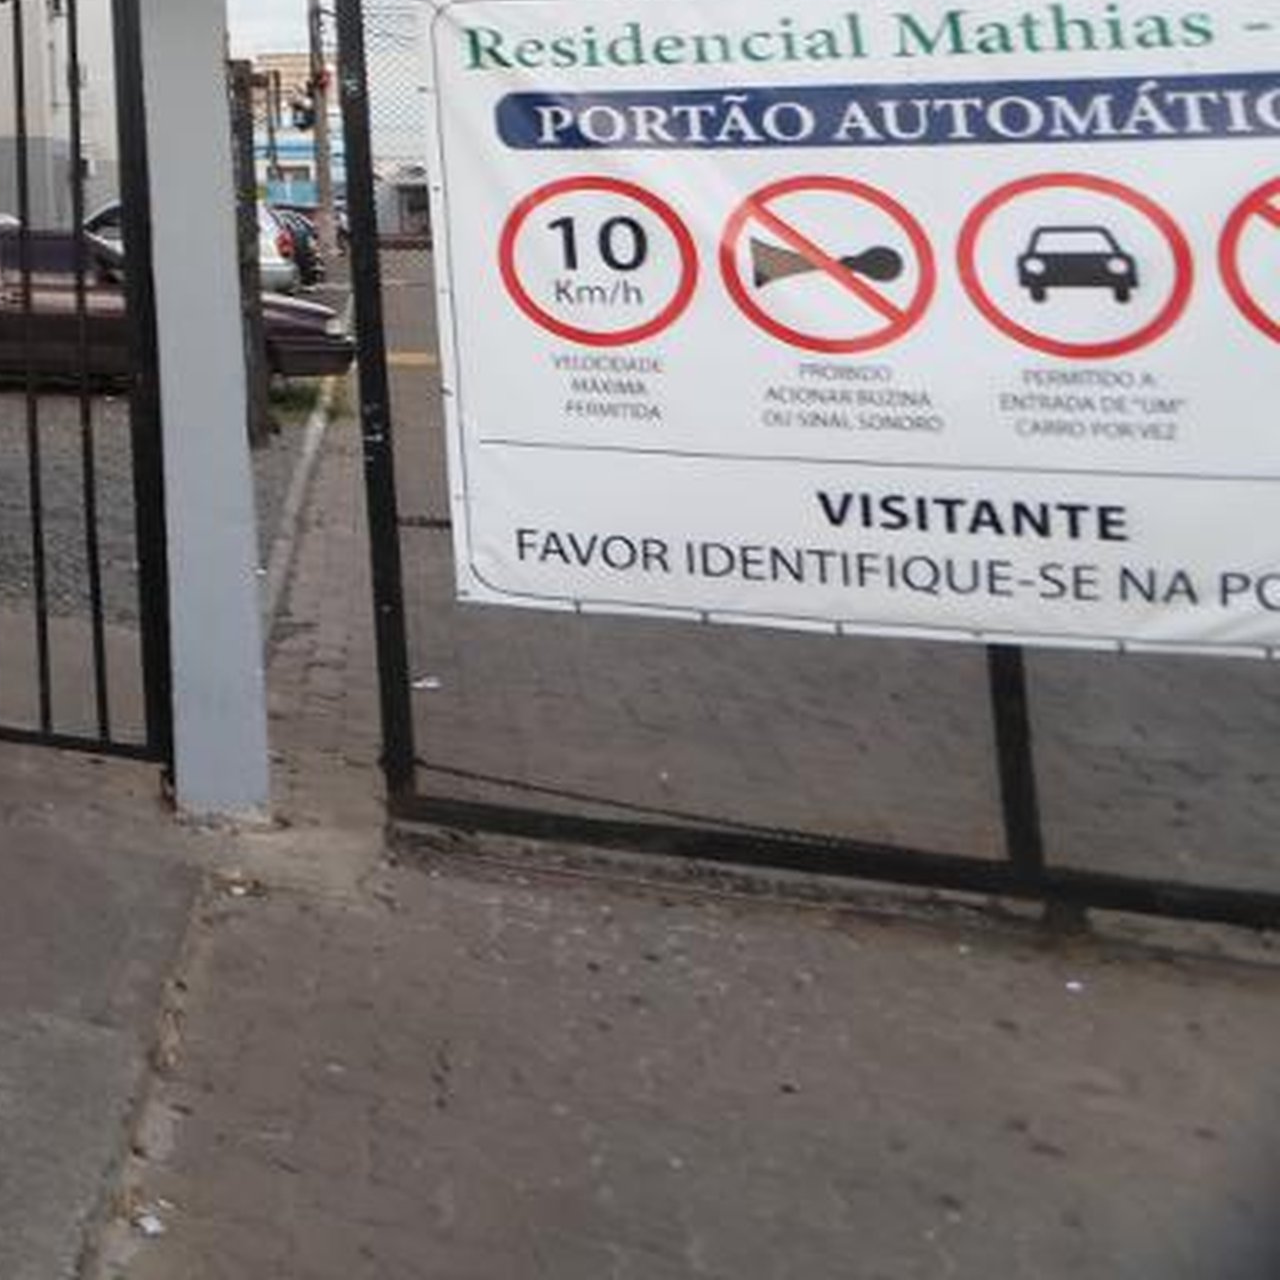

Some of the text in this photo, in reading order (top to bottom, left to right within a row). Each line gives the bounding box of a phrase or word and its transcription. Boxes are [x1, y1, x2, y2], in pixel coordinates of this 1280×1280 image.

[462, 12, 868, 70] Residencial
[892, 2, 1215, 58] Mathias
[536, 95, 815, 144] PORTÃO
[547, 215, 648, 272] 10
[555, 279, 643, 306] Km/h
[1022, 369, 1135, 388] PERMITIDO
[764, 385, 932, 407] ACIONAR BUZINA
[999, 393, 1096, 413] ENTRADA
[1100, 396, 1126, 413] DE
[761, 408, 792, 428] OU
[796, 410, 853, 430] SINAL
[1014, 419, 1177, 441] CARRO POR VEZ
[816, 491, 1129, 542] VISITANTE
[515, 527, 670, 573] FAVOR
[686, 540, 1101, 602] IDENTIFIQUE-SE
[1119, 567, 1199, 606] NA
